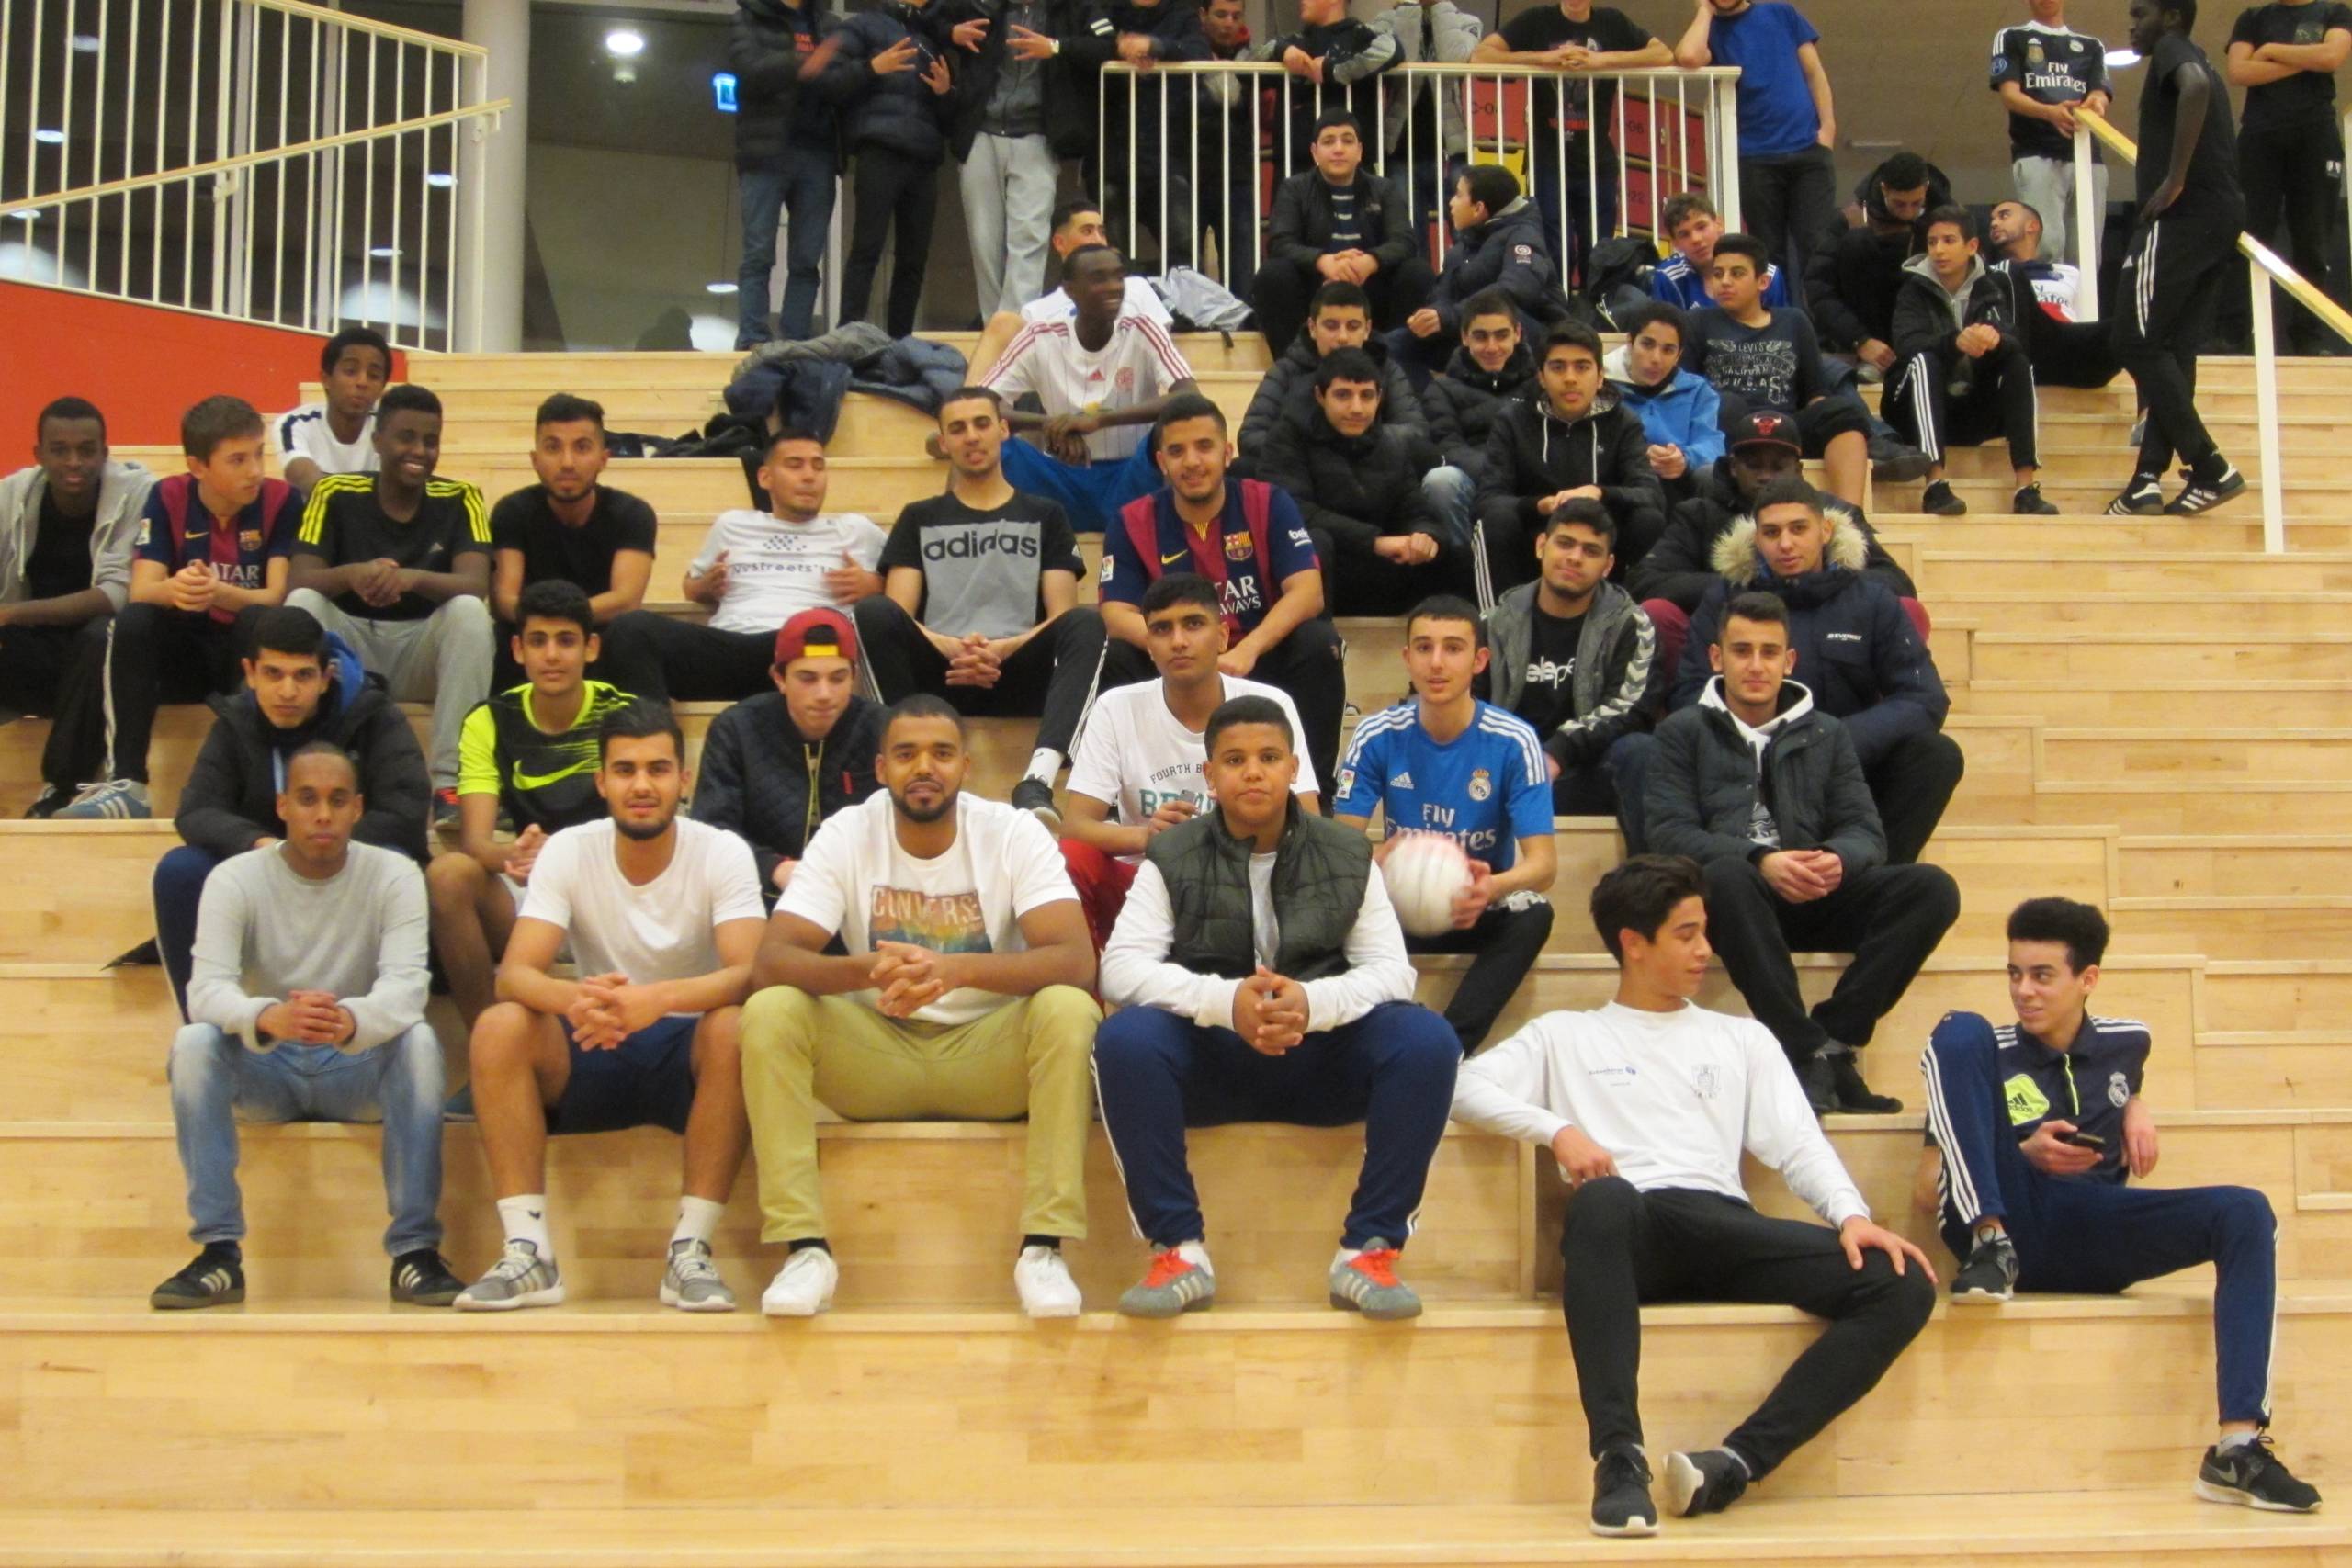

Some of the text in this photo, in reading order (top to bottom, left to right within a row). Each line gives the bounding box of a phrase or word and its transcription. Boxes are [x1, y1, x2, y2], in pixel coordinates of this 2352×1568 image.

[2048, 62, 2069, 74] Fly
[2024, 73, 2087, 93] Emirates
[923, 530, 1037, 561] adidas
[209, 561, 260, 581] ATAR
[1219, 595, 1261, 616] WAYS
[1149, 763, 1192, 784] FOURTH
[1422, 803, 1455, 827] Fly
